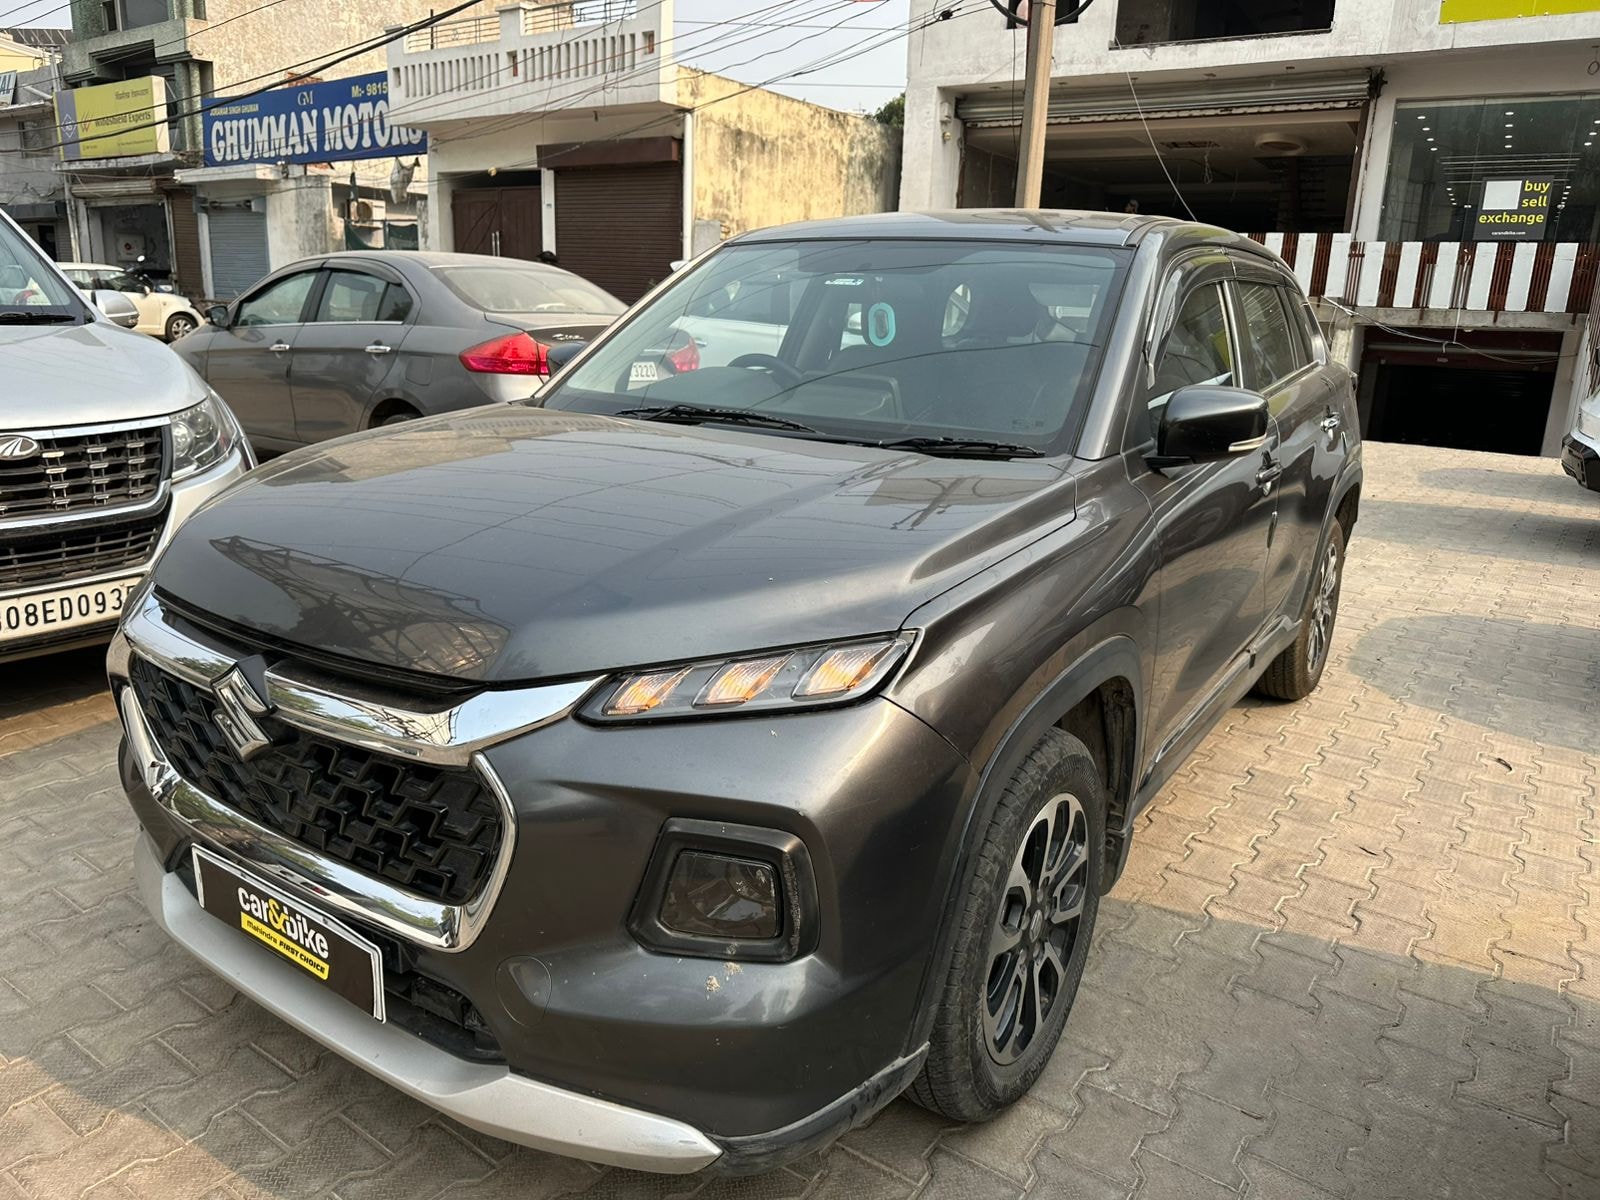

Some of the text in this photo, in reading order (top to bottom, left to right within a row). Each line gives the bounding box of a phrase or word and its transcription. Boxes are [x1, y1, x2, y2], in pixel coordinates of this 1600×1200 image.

[366, 82, 388, 96] 9815
[211, 109, 318, 162] GHUMMAN
[1521, 195, 1547, 207] sell
[1524, 180, 1551, 193] buy
[1478, 211, 1544, 225] exchange
[0, 585, 135, 631] 08ED093
[237, 887, 329, 959] car&bike
[246, 920, 326, 974] mahindra FIRST CHOICE
